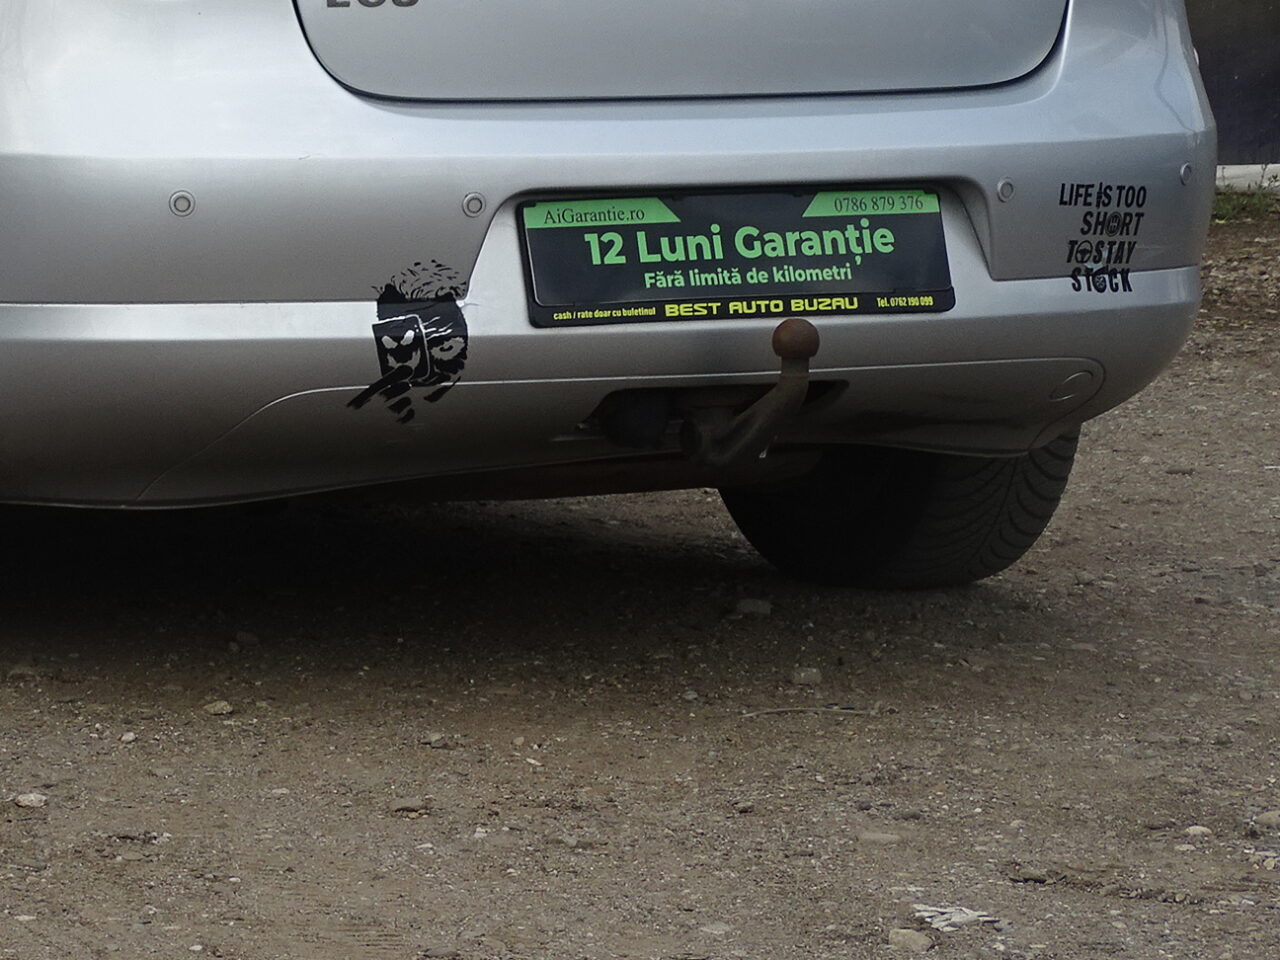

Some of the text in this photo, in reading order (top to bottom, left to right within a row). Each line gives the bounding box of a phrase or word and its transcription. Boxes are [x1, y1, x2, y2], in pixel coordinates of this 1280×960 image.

[834, 195, 923, 212] 0786 879 376
[1059, 182, 1146, 209] LIFE IS TOO
[544, 207, 645, 226] AiGarantie.ro
[1080, 211, 1145, 237] SHORT
[584, 218, 895, 266] 12 Luni Garanție
[1093, 240, 1137, 264] STAY
[644, 263, 852, 289] Fără limită de kilometri
[553, 311, 572, 320] cash
[577, 310, 593, 319] rate
[594, 308, 611, 318] doar
[664, 297, 858, 317] BEST AUTO BUZAU
